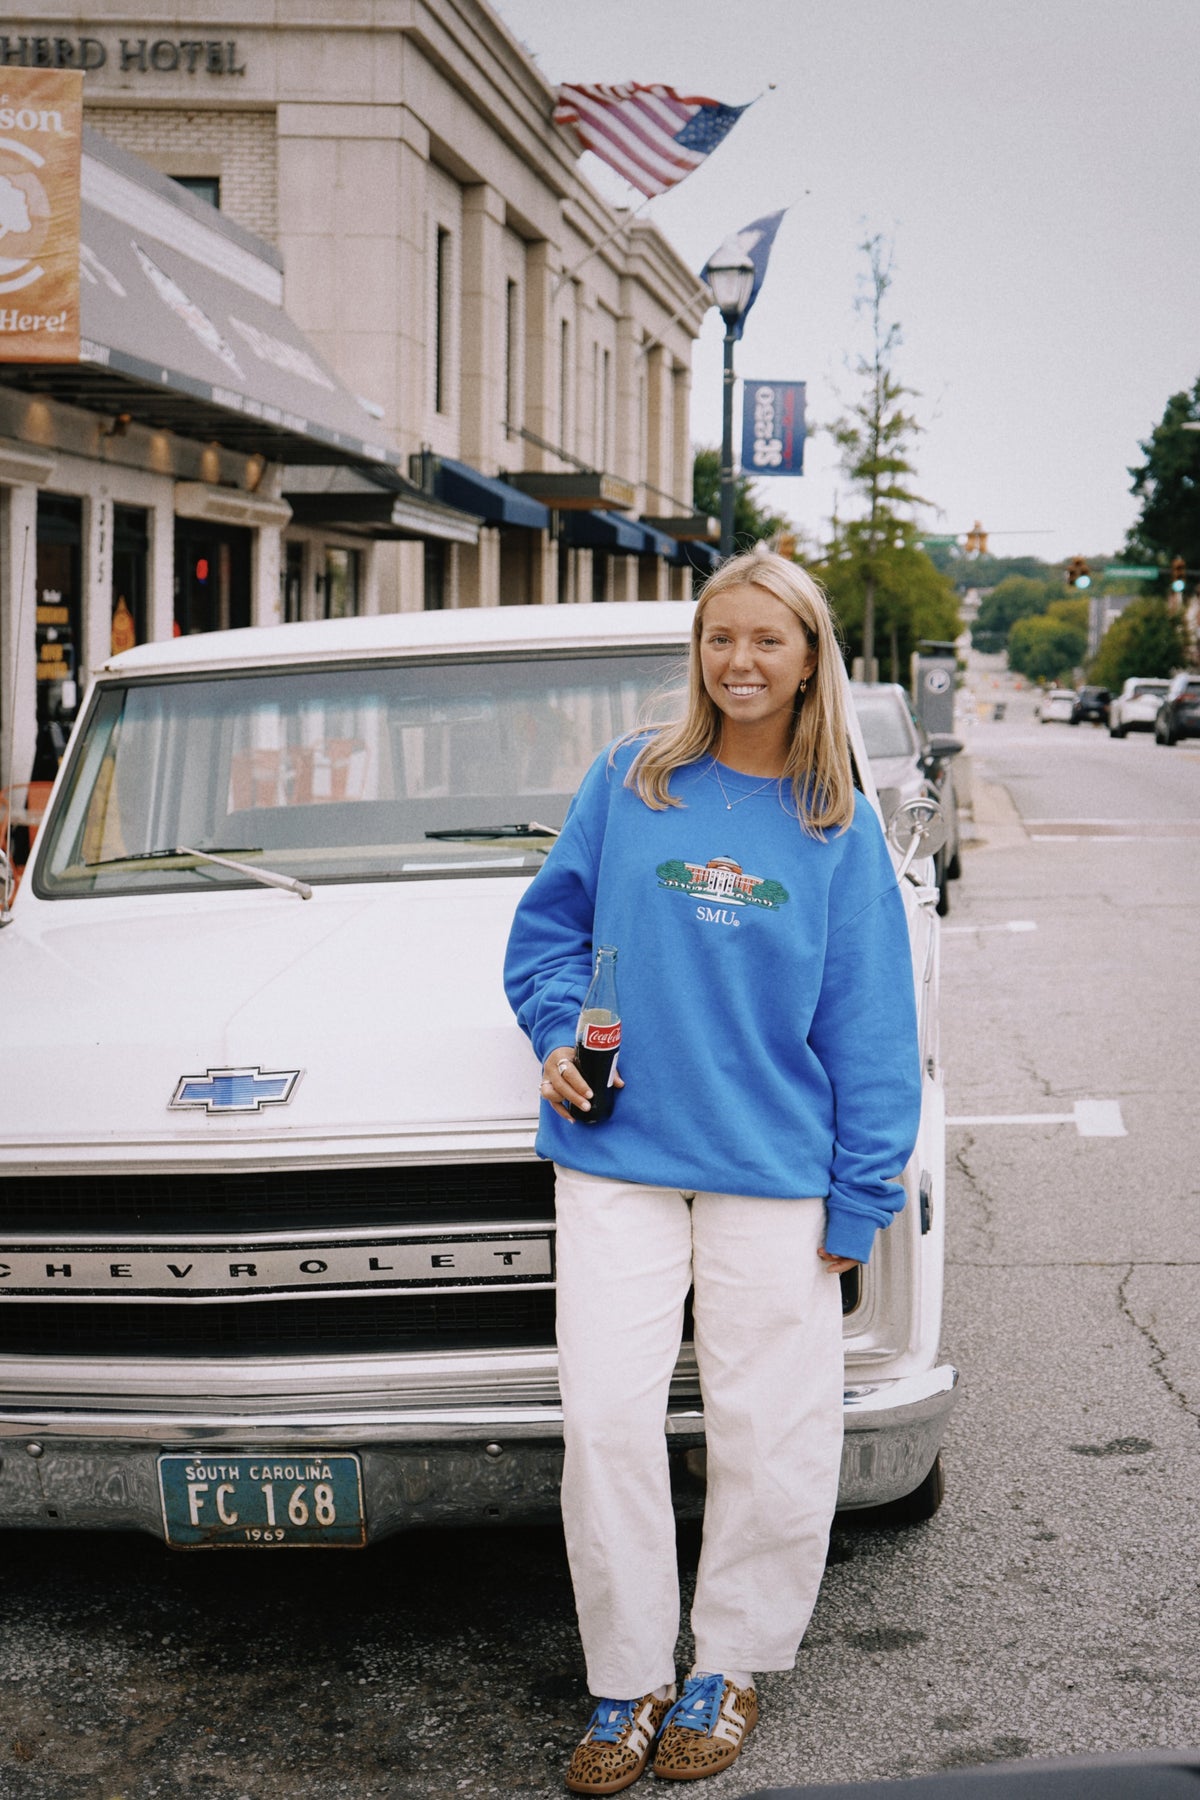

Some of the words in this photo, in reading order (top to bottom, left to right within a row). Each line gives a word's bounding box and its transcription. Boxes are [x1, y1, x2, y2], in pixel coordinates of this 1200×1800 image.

[119, 38, 246, 76] HOTEL
[0, 309, 67, 333] Here!
[185, 1465, 240, 1481] SOUTH
[249, 1465, 334, 1481] CAROLINA
[187, 1483, 239, 1526] FC
[261, 1483, 336, 1526] 168
[244, 1529, 286, 1541] 1969
